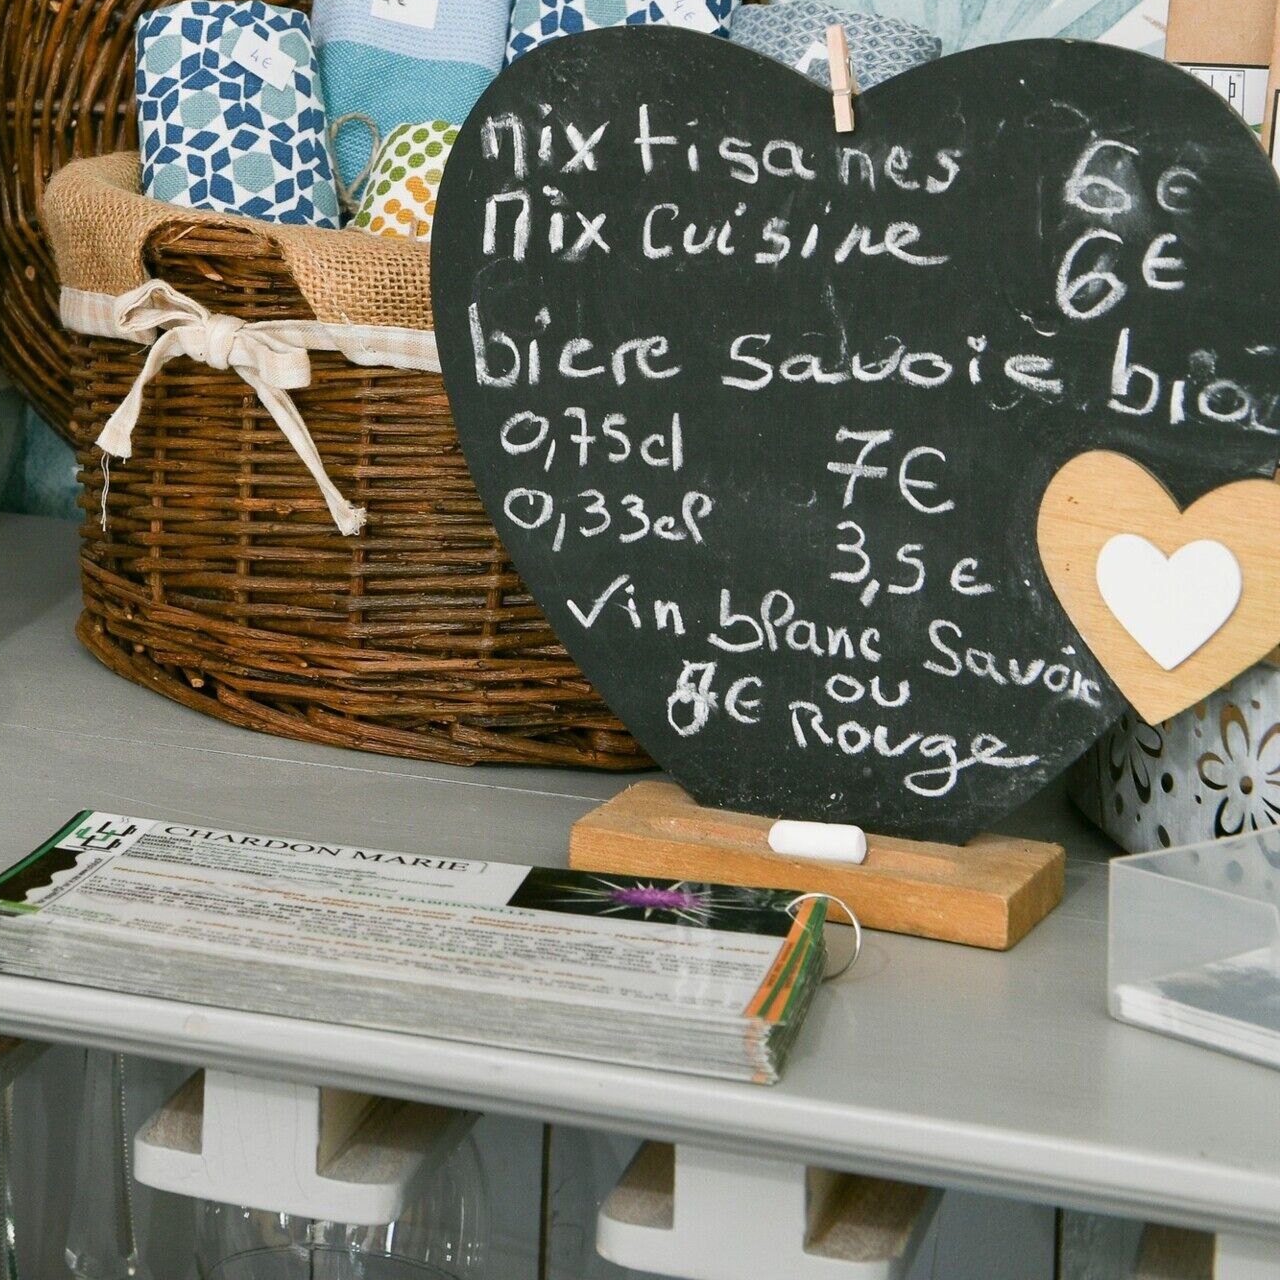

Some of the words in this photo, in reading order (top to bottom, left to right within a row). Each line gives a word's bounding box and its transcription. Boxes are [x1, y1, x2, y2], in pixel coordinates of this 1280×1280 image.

[825, 673, 911, 708] ou
[788, 699, 1041, 798] Rouge
[164, 825, 343, 858] CHARDON
[351, 849, 471, 873] MARIE
